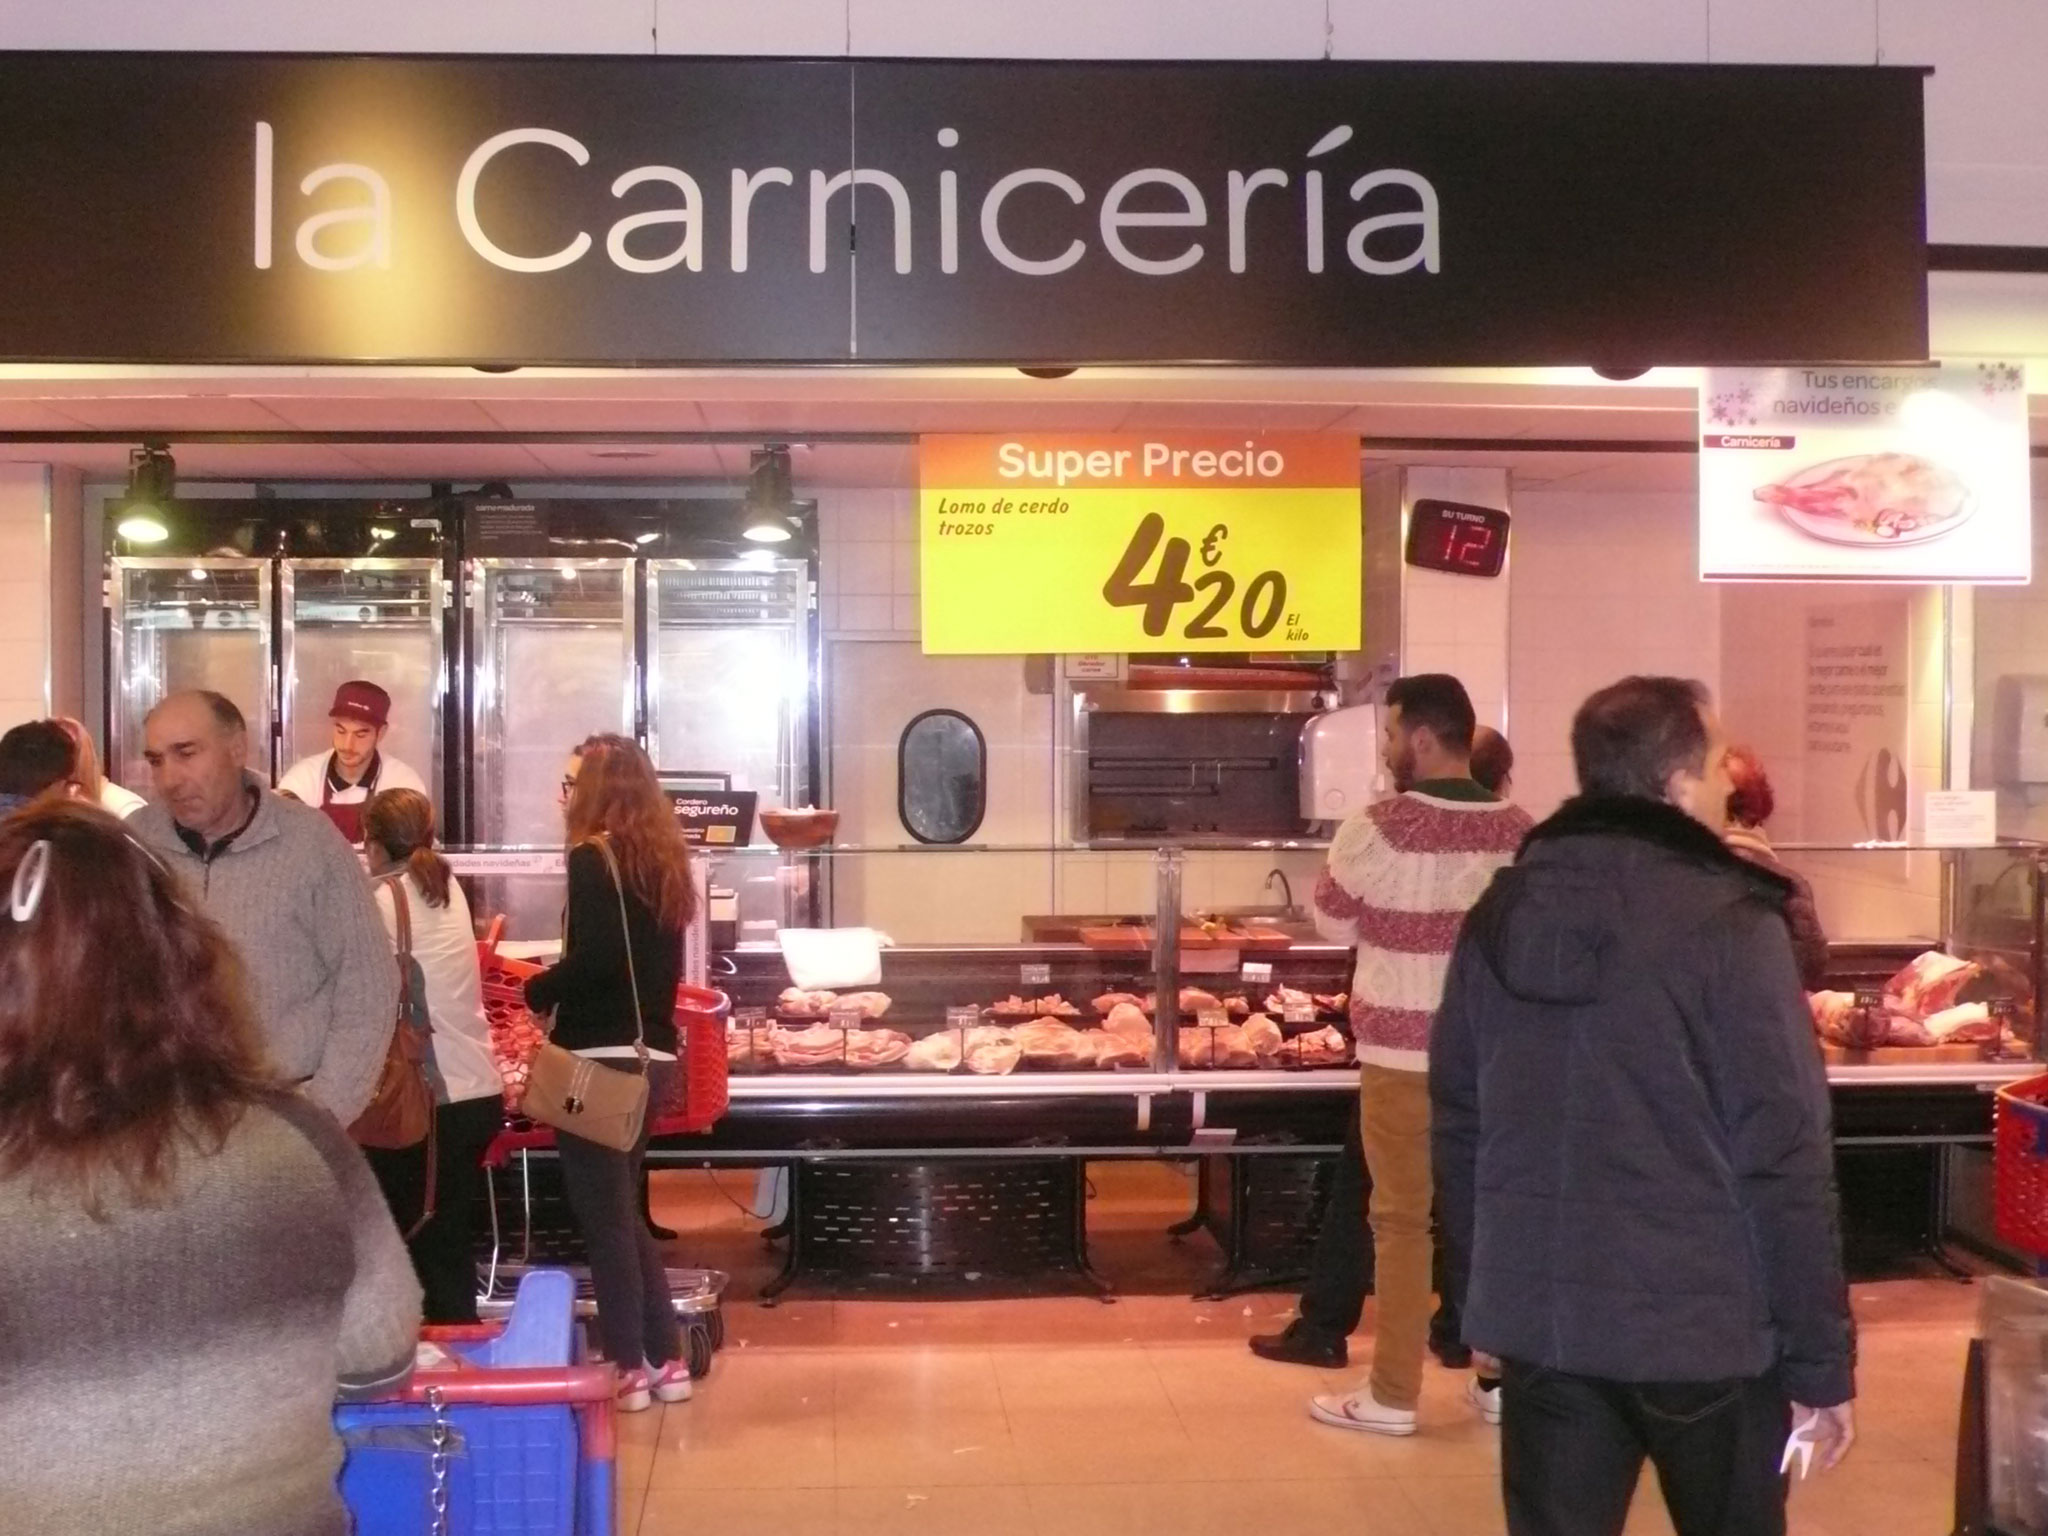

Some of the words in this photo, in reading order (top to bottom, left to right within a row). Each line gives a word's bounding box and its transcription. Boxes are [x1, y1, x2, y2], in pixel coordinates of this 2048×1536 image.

[254, 121, 392, 271] la
[456, 125, 1440, 276] Carnicería
[1802, 371, 1838, 389] Tus
[1774, 396, 1880, 415] navideños
[1721, 435, 1781, 449] Carnicería
[998, 443, 1131, 486] Super
[1143, 441, 1285, 477] Precio
[938, 498, 986, 515] Lomo
[991, 497, 1013, 515] de
[1018, 496, 1069, 515] cerdo
[1441, 509, 1454, 519] SU
[1456, 511, 1486, 524] TURNO
[938, 520, 994, 537] trozos
[1443, 524, 1492, 566] 12
[1286, 613, 1300, 627] El
[1286, 628, 1309, 642] kilo
[673, 803, 739, 818] segureño
[675, 798, 708, 806] Cordero
